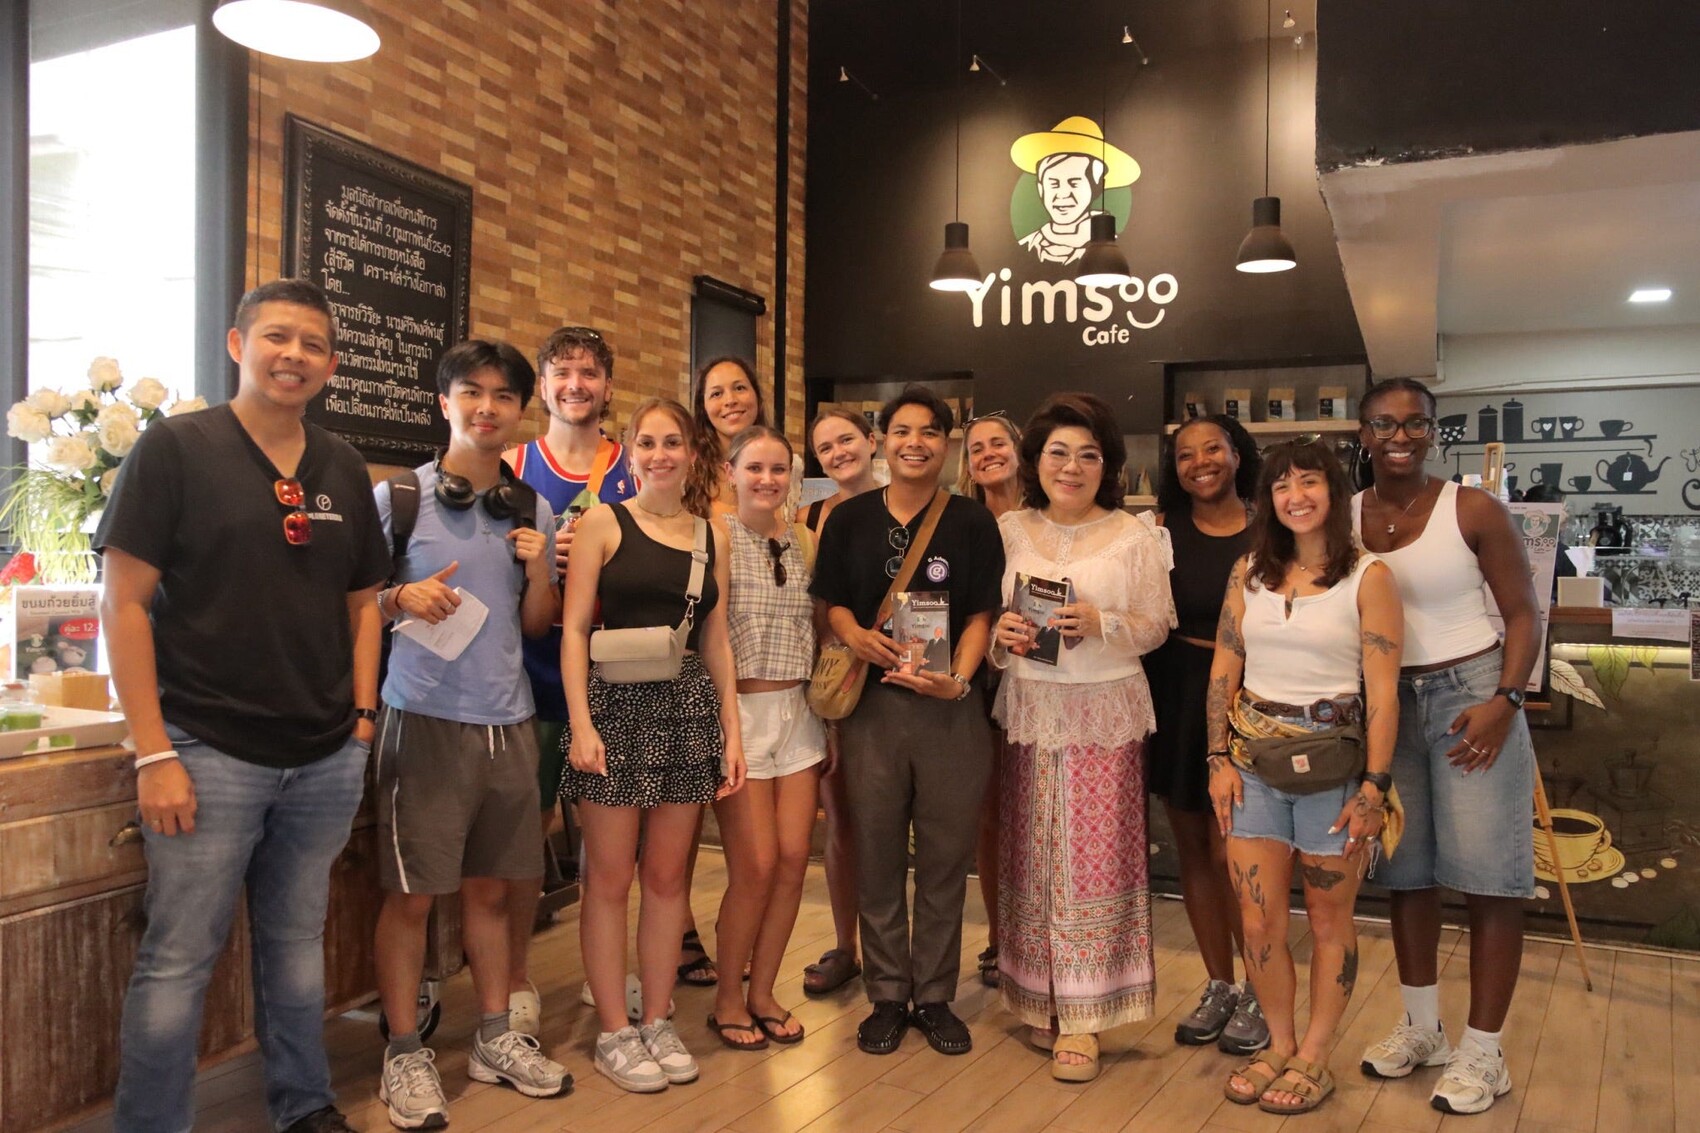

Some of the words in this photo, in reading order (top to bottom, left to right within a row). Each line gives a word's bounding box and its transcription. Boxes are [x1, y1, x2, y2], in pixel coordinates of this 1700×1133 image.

[385, 224, 391, 238] 2
[432, 240, 452, 257] 2542
[965, 268, 1179, 328] Yimsoo
[1082, 324, 1130, 347] Cafe
